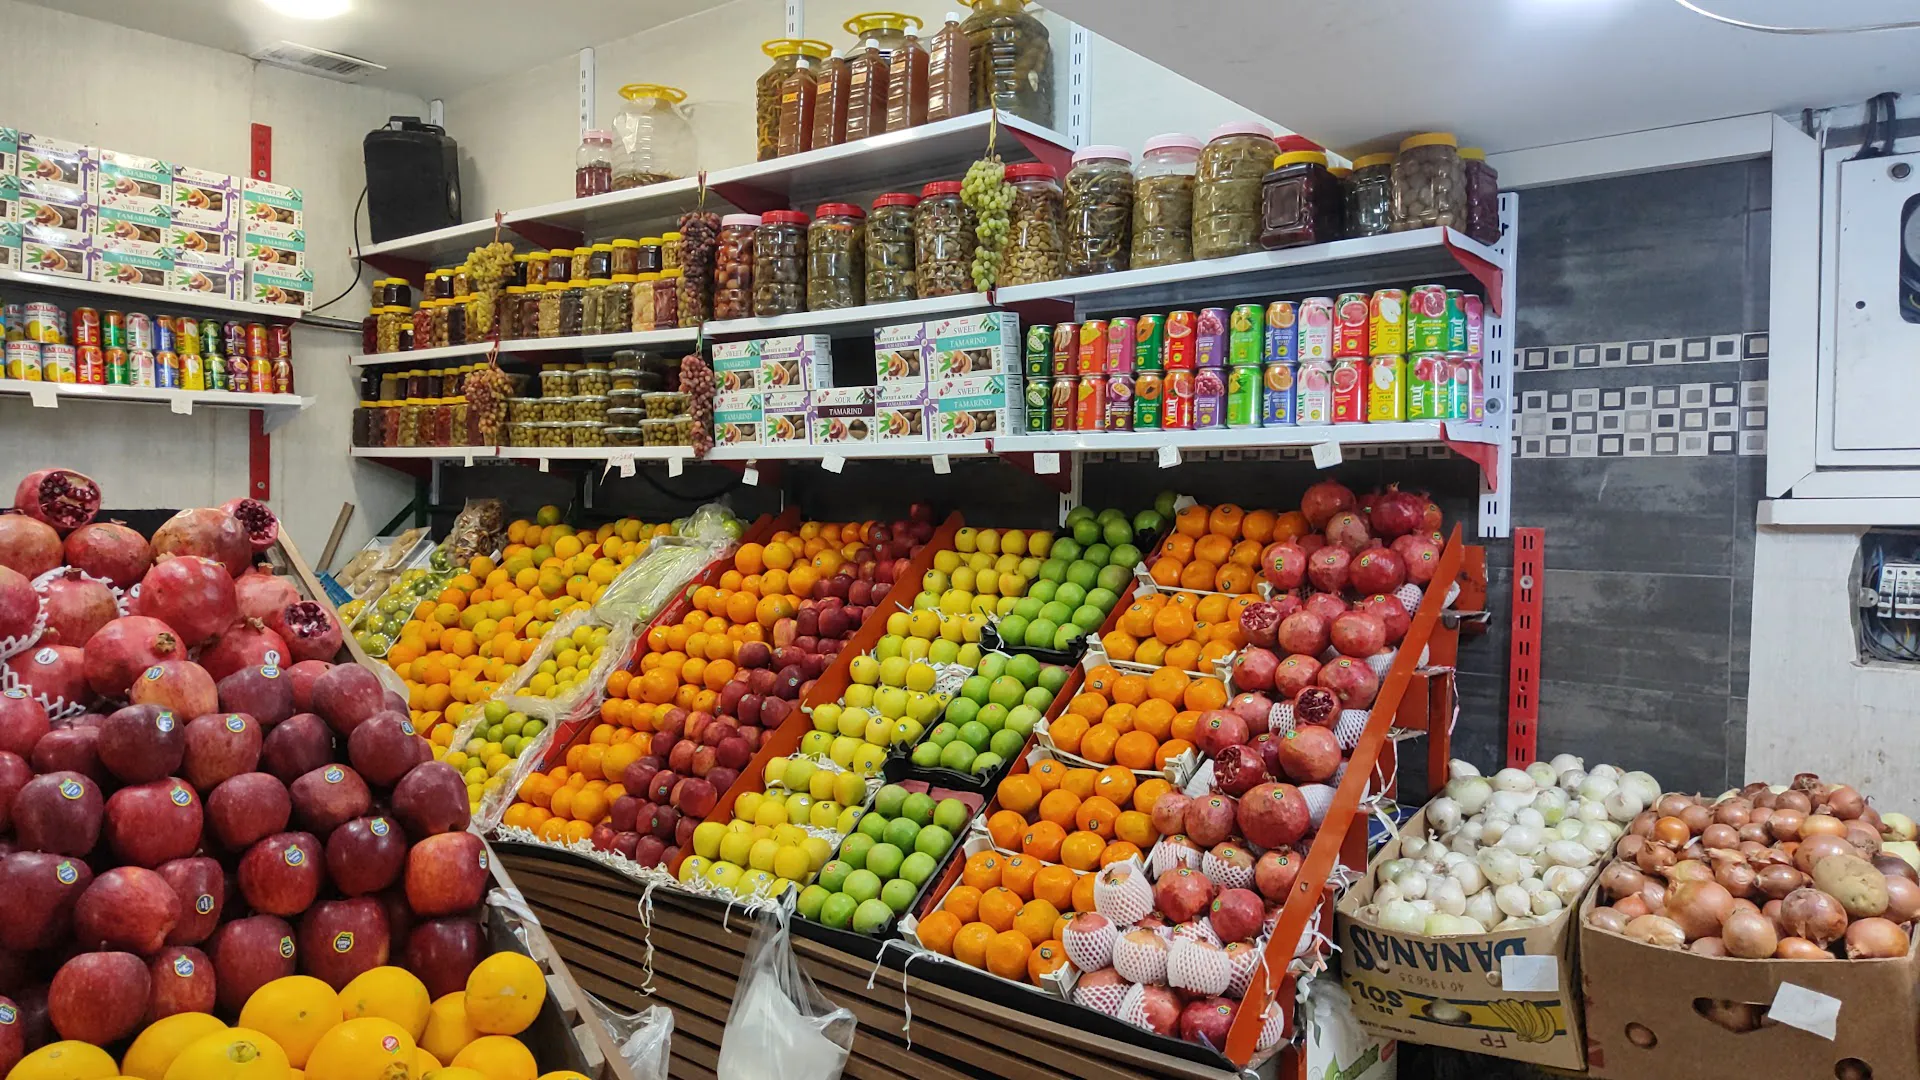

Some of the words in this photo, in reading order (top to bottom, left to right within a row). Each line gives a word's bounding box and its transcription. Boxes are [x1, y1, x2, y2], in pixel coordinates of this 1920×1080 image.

[953, 324, 976, 334] SWEET
[950, 336, 987, 348] TAMARIND
[957, 387, 981, 395] SWEET
[834, 396, 851, 404] SOUR
[954, 398, 992, 409] TAMARIND
[1410, 384, 1425, 418] Vinut
[828, 407, 863, 416] TAMARIND
[1165, 397, 1179, 426] Vinut
[1352, 980, 1404, 1008] SOL
[1369, 1003, 1394, 1015] DEL
[1479, 1033, 1508, 1049] FP
